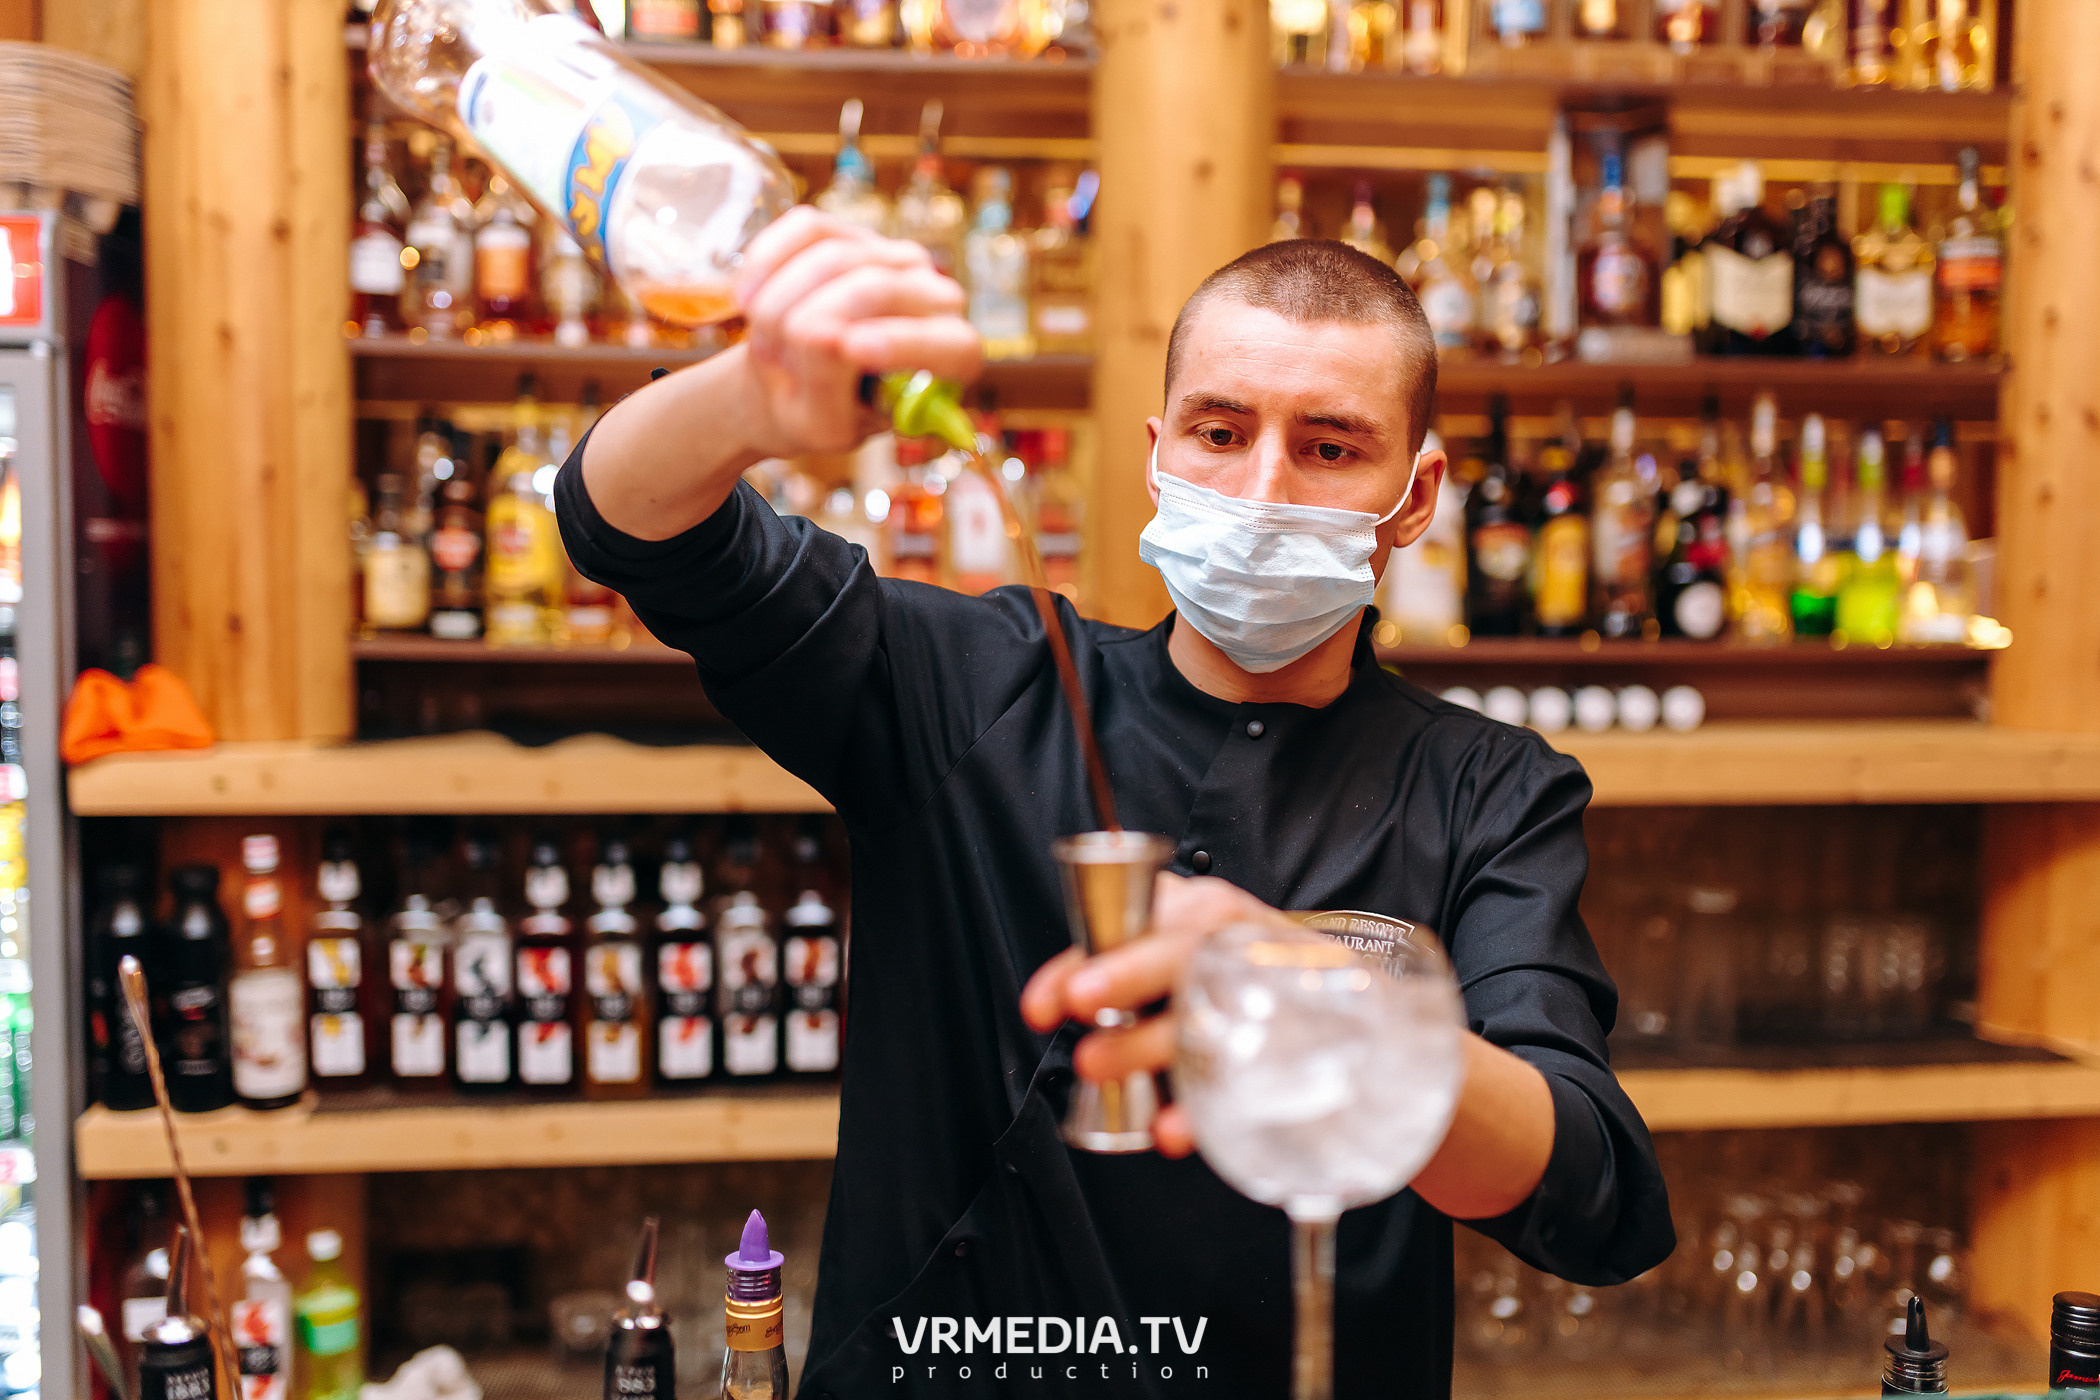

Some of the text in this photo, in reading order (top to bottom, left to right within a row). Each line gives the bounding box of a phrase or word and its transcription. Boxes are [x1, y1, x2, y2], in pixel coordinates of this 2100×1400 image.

[1309, 917, 1407, 940] RAND RESORT
[1325, 934, 1395, 955] TAURANT
